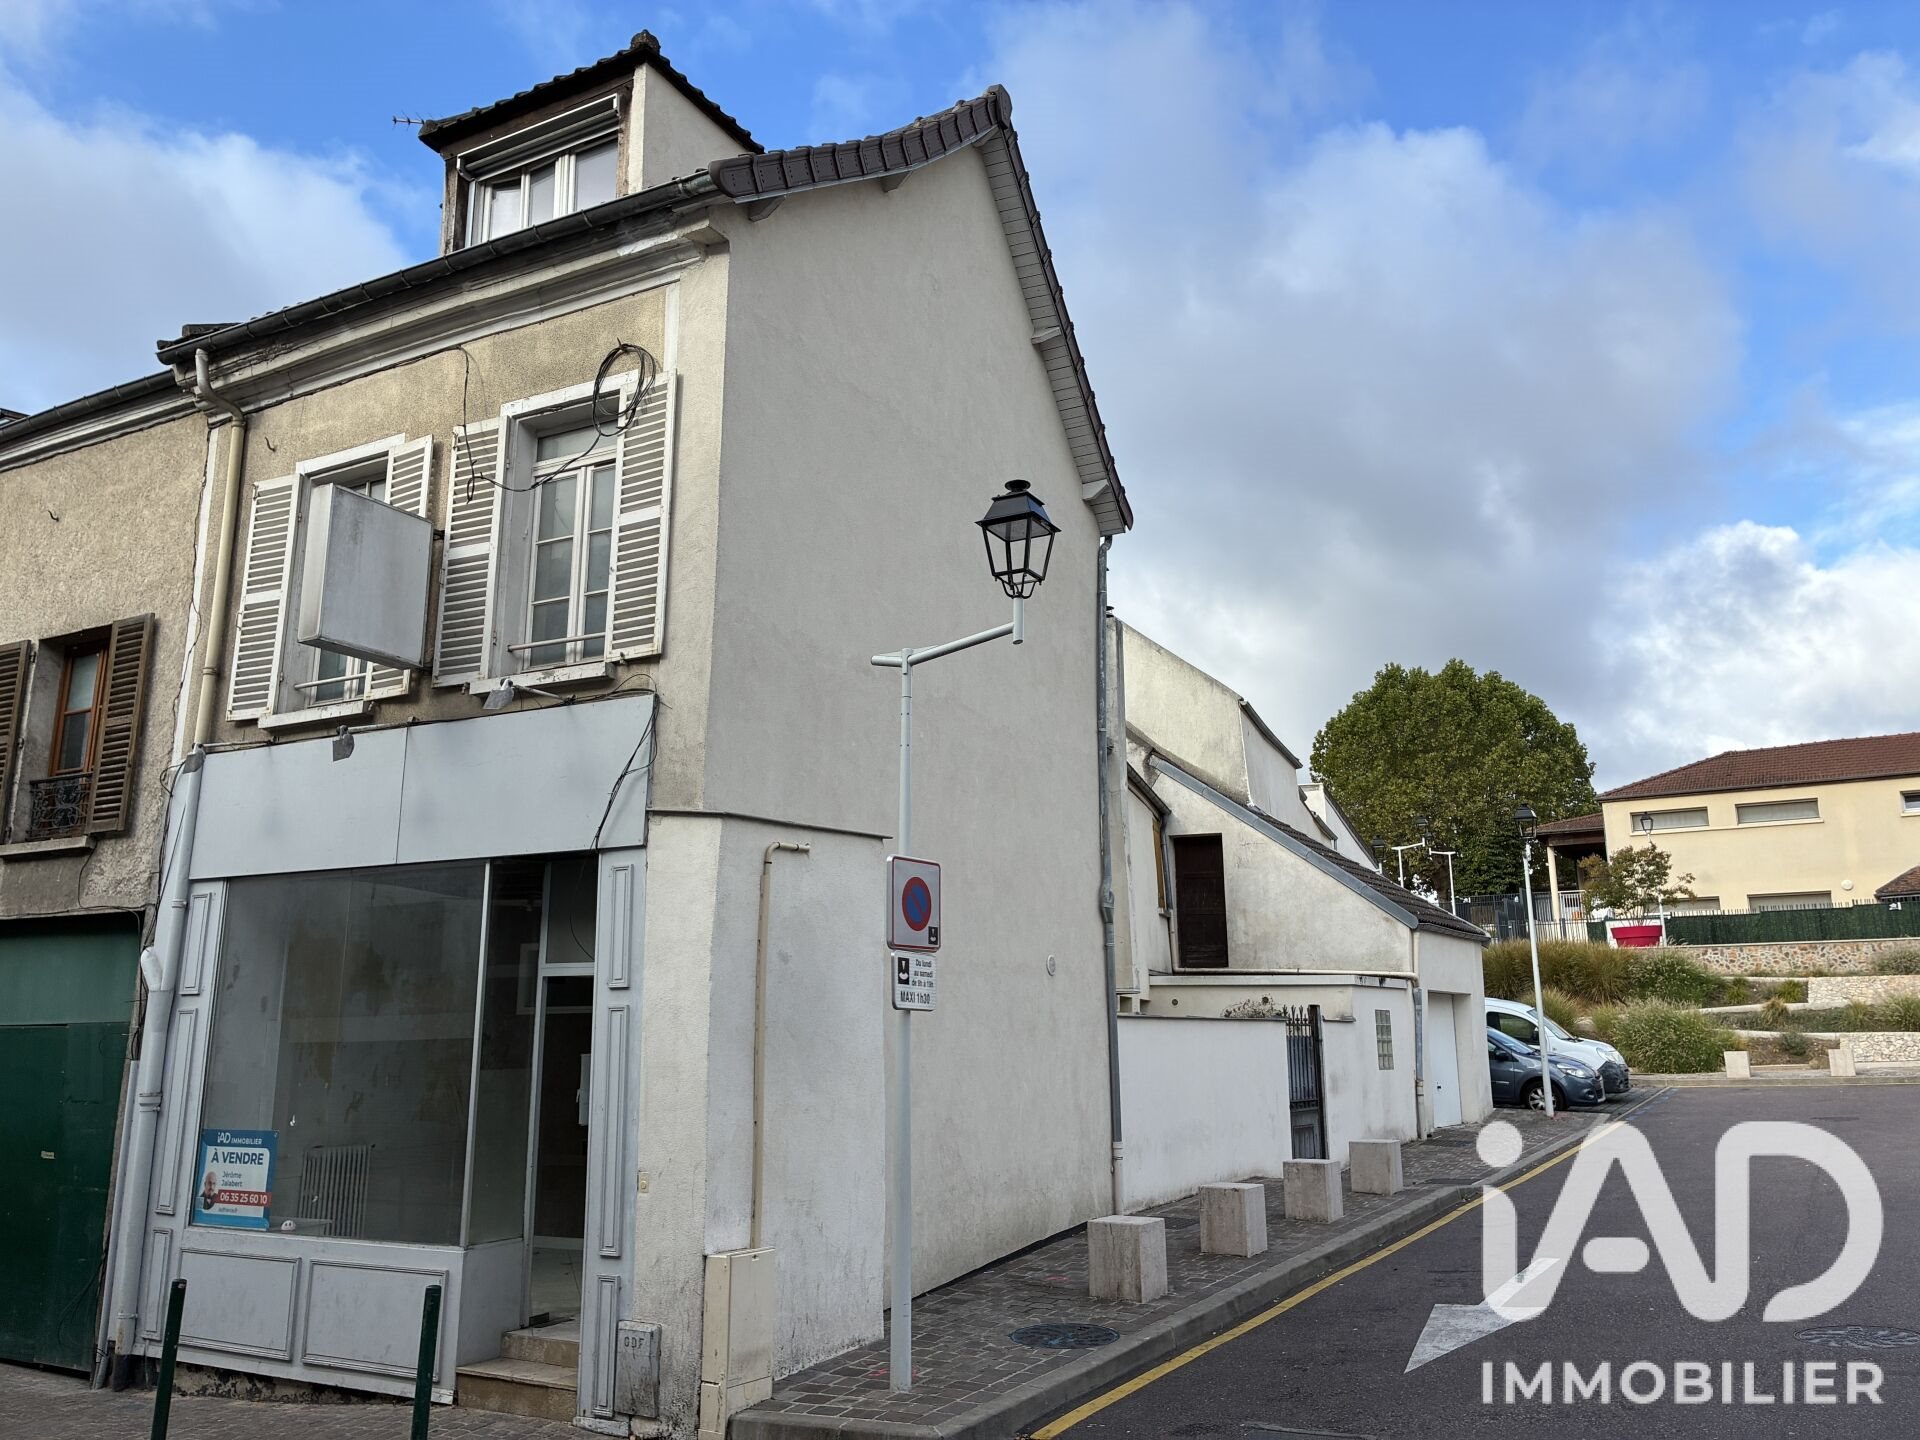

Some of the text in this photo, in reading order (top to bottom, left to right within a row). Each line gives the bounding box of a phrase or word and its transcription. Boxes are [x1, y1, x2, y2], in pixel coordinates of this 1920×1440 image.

[900, 991, 930, 1004] MAXI 1h30
[217, 1132, 231, 1144] iAD
[211, 1148, 264, 1165] À VENDRE
[222, 1171, 242, 1179] Jérôme
[220, 1192, 268, 1204] 06 35 25 60 10
